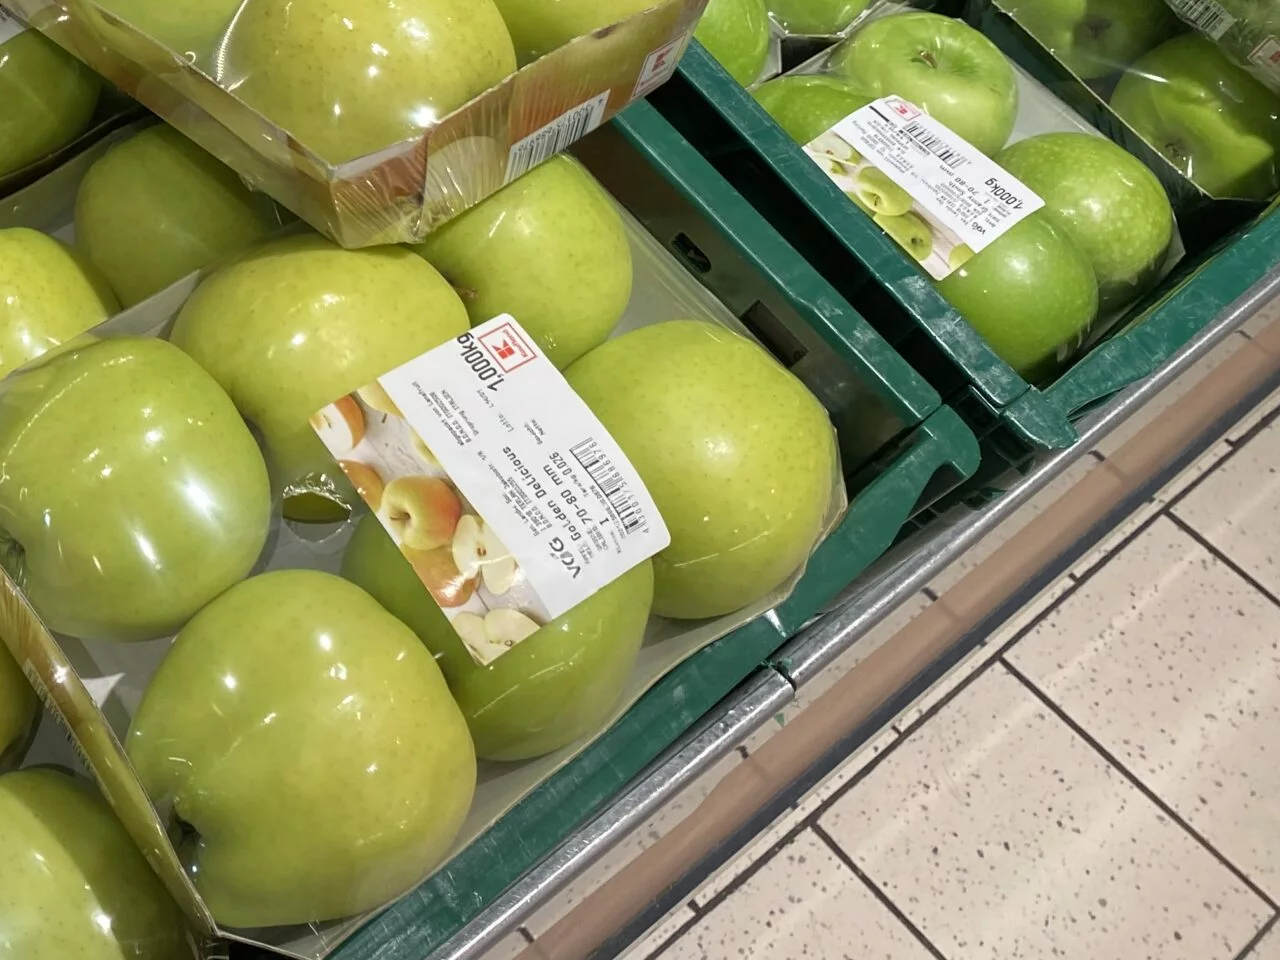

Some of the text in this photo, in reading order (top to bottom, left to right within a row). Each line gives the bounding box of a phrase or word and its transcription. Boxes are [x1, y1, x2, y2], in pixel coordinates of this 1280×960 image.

[457, 331, 503, 390] 1,000kg
[542, 464, 563, 485] mm
[548, 451, 572, 475] 0.026
[502, 446, 581, 540] Golden Delicious
[560, 489, 592, 524] 70-80
